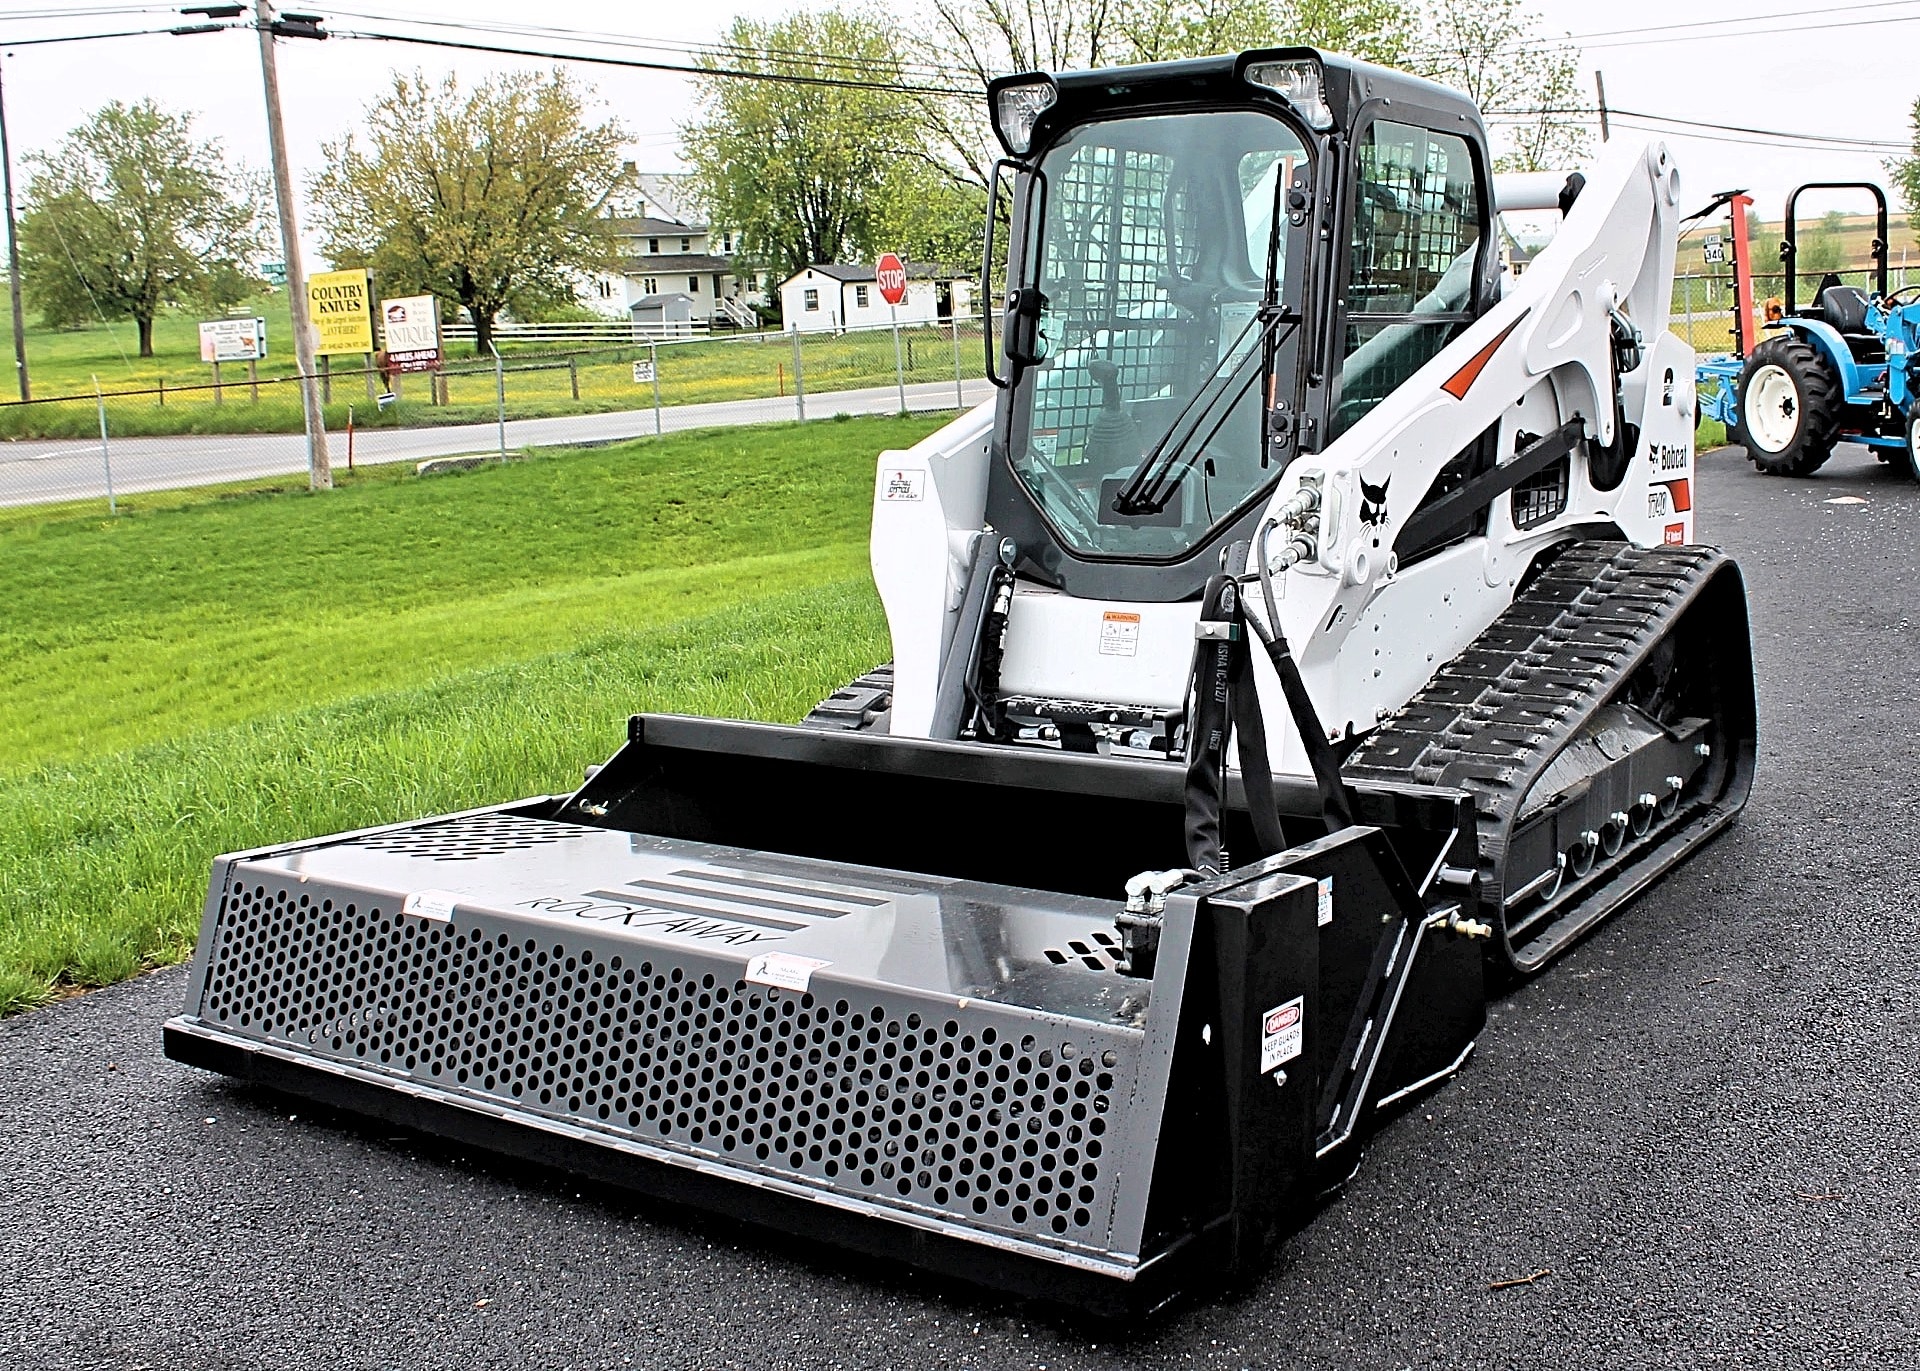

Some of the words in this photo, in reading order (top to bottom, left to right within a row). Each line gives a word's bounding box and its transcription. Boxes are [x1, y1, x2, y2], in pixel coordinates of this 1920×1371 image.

[1706, 249, 1723, 260] 340
[879, 269, 904, 290] STOP
[311, 284, 363, 300] COUNTRY
[319, 299, 361, 313] KNIVES
[414, 350, 437, 361] AHEAD
[1661, 443, 1687, 471] Bobcat
[1111, 613, 1138, 622] WARNING
[514, 896, 787, 946] ROCKAWAY
[1270, 1009, 1297, 1031] DANGER
[1264, 1038, 1278, 1053] KEEP
[1278, 1028, 1300, 1047] GUARDS
[1269, 1052, 1276, 1064] IN
[1276, 1044, 1294, 1060] PLACE
